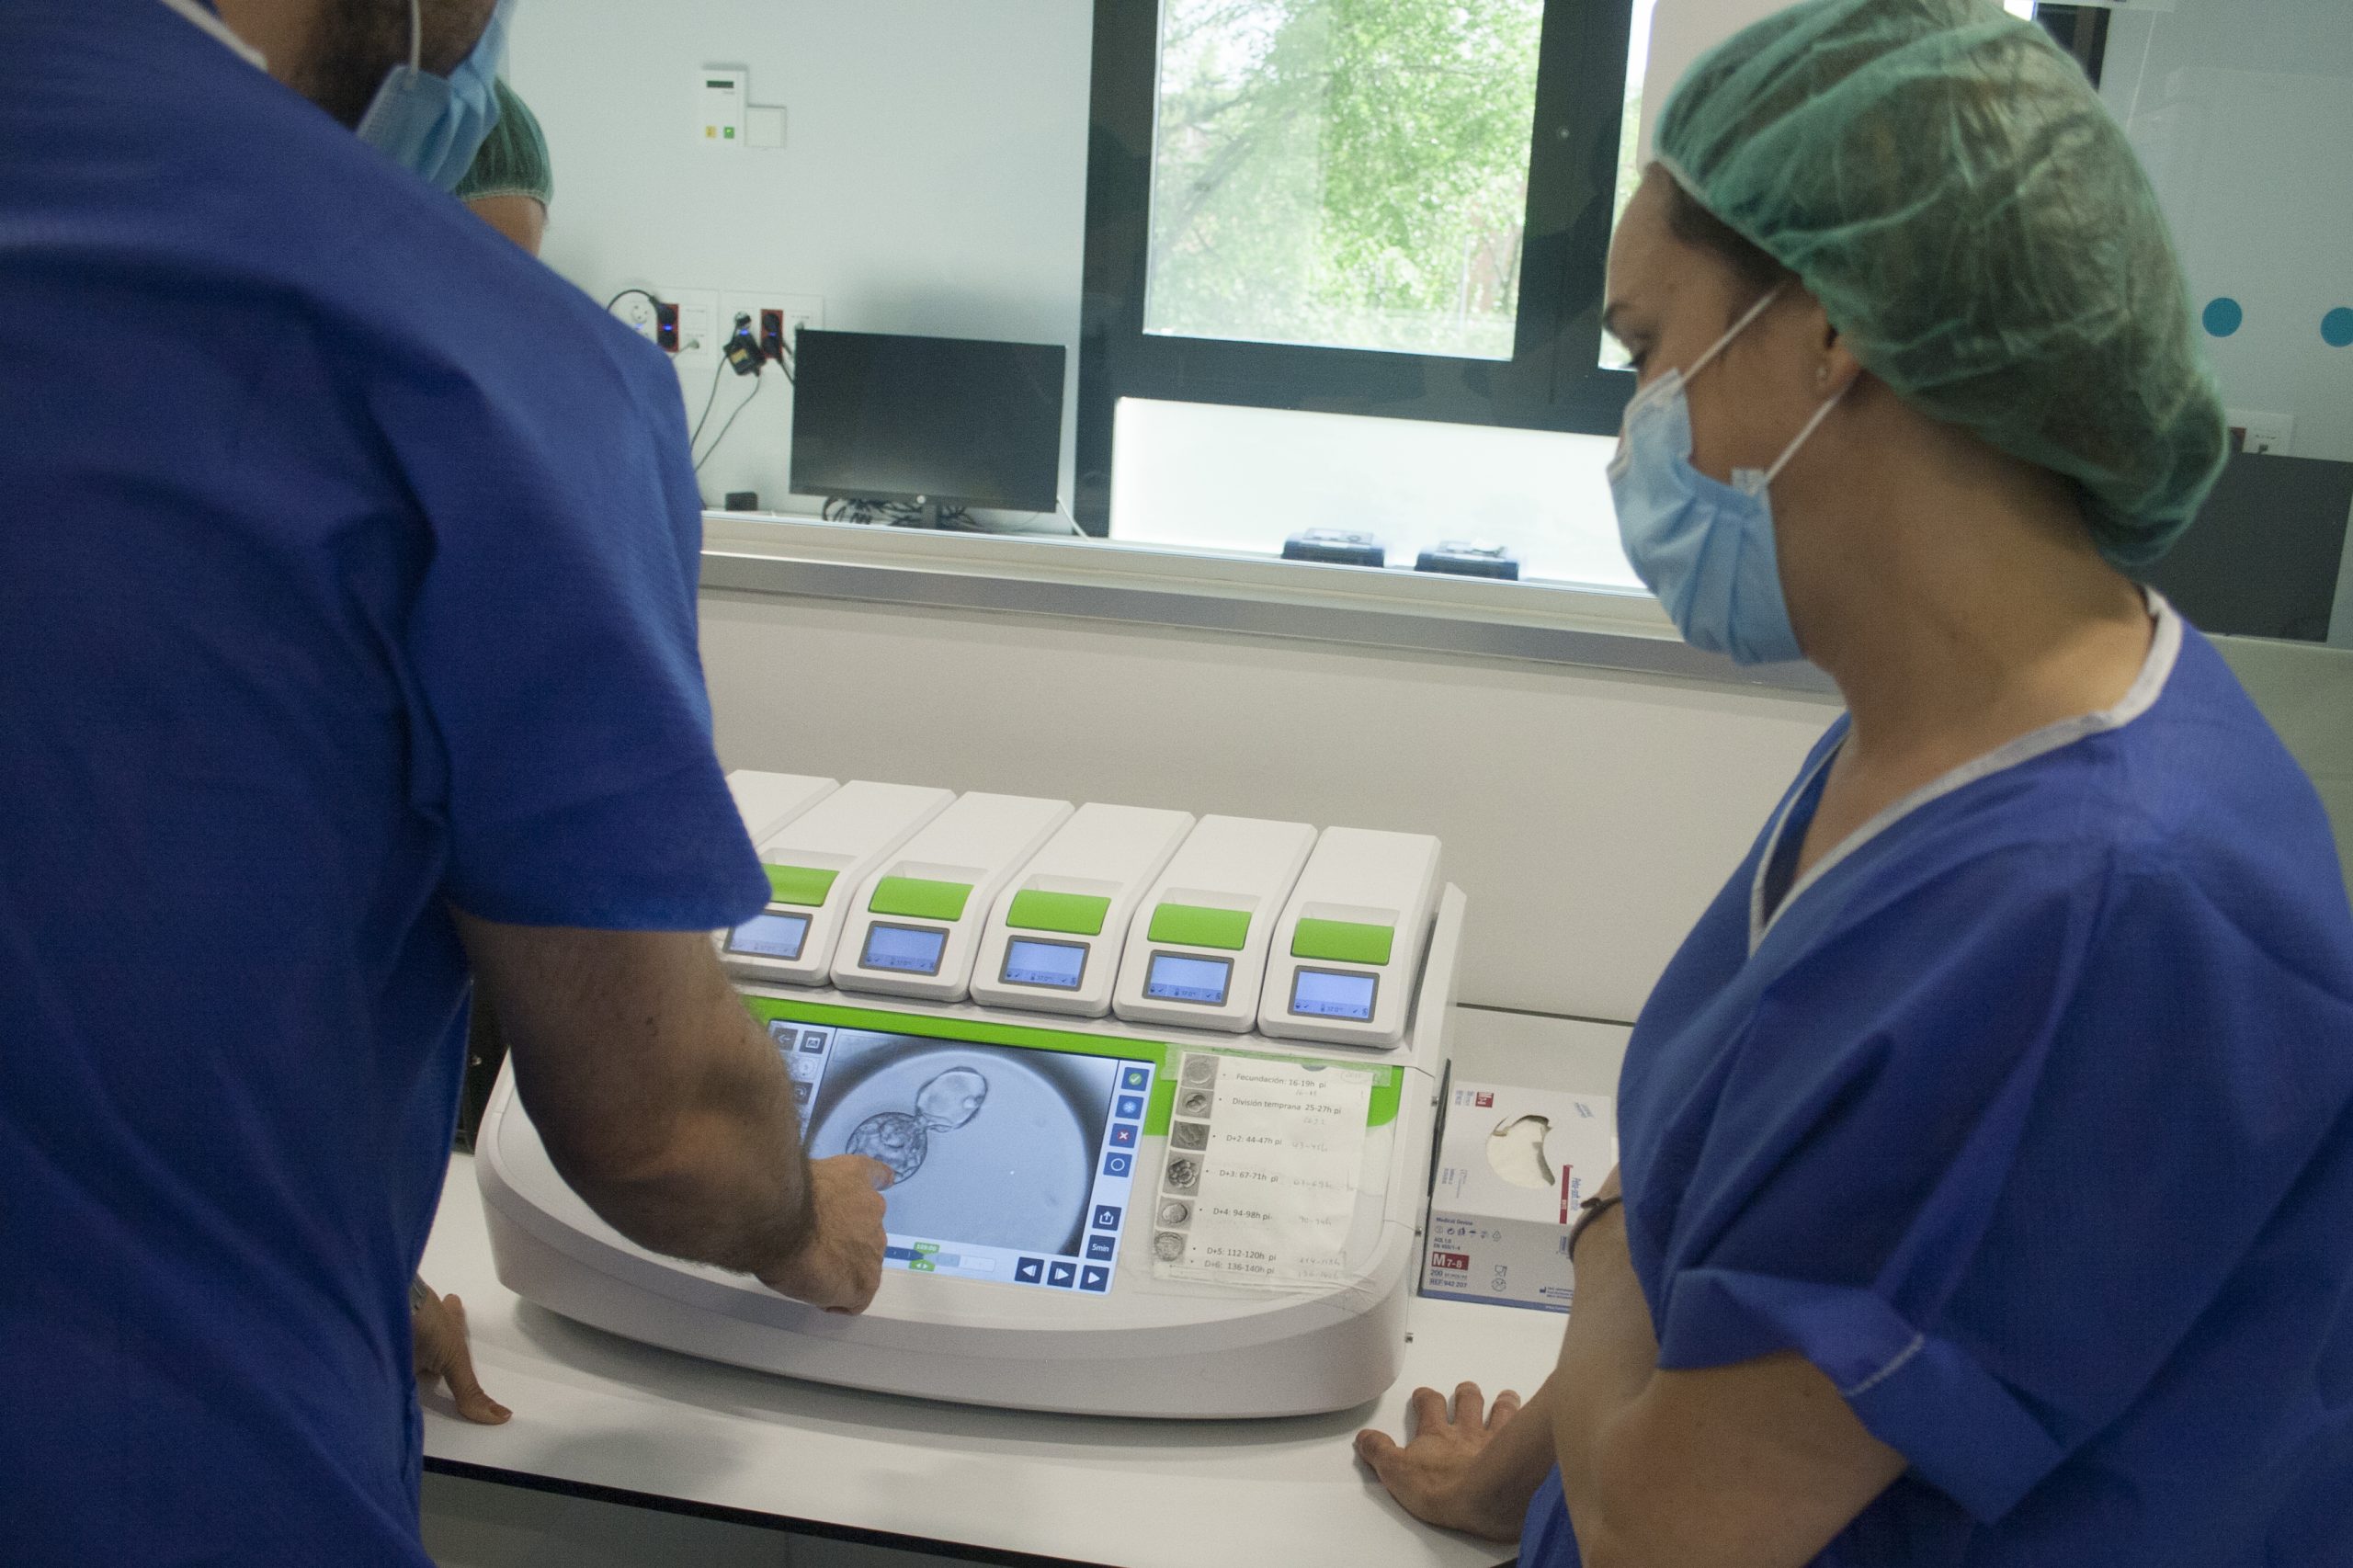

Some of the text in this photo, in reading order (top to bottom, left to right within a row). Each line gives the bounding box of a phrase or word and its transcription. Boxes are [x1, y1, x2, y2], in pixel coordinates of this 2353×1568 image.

[1236, 1073, 1326, 1089] Fecundación: 16-19h pi
[1232, 1097, 1342, 1115] División temprana 25-27h pi
[1226, 1134, 1282, 1146] D+2: 44-47h pi
[1219, 1169, 1279, 1184] D+3: 67-71h pi
[1212, 1207, 1231, 1217] D+4:
[1233, 1209, 1260, 1220] 94-98h
[1091, 1243, 1109, 1252] 5min
[1207, 1246, 1277, 1263] D+5: 112-120h pi
[1204, 1259, 1275, 1275] D+6: 136-140h pi
[1433, 1253, 1462, 1268] M 7-8
